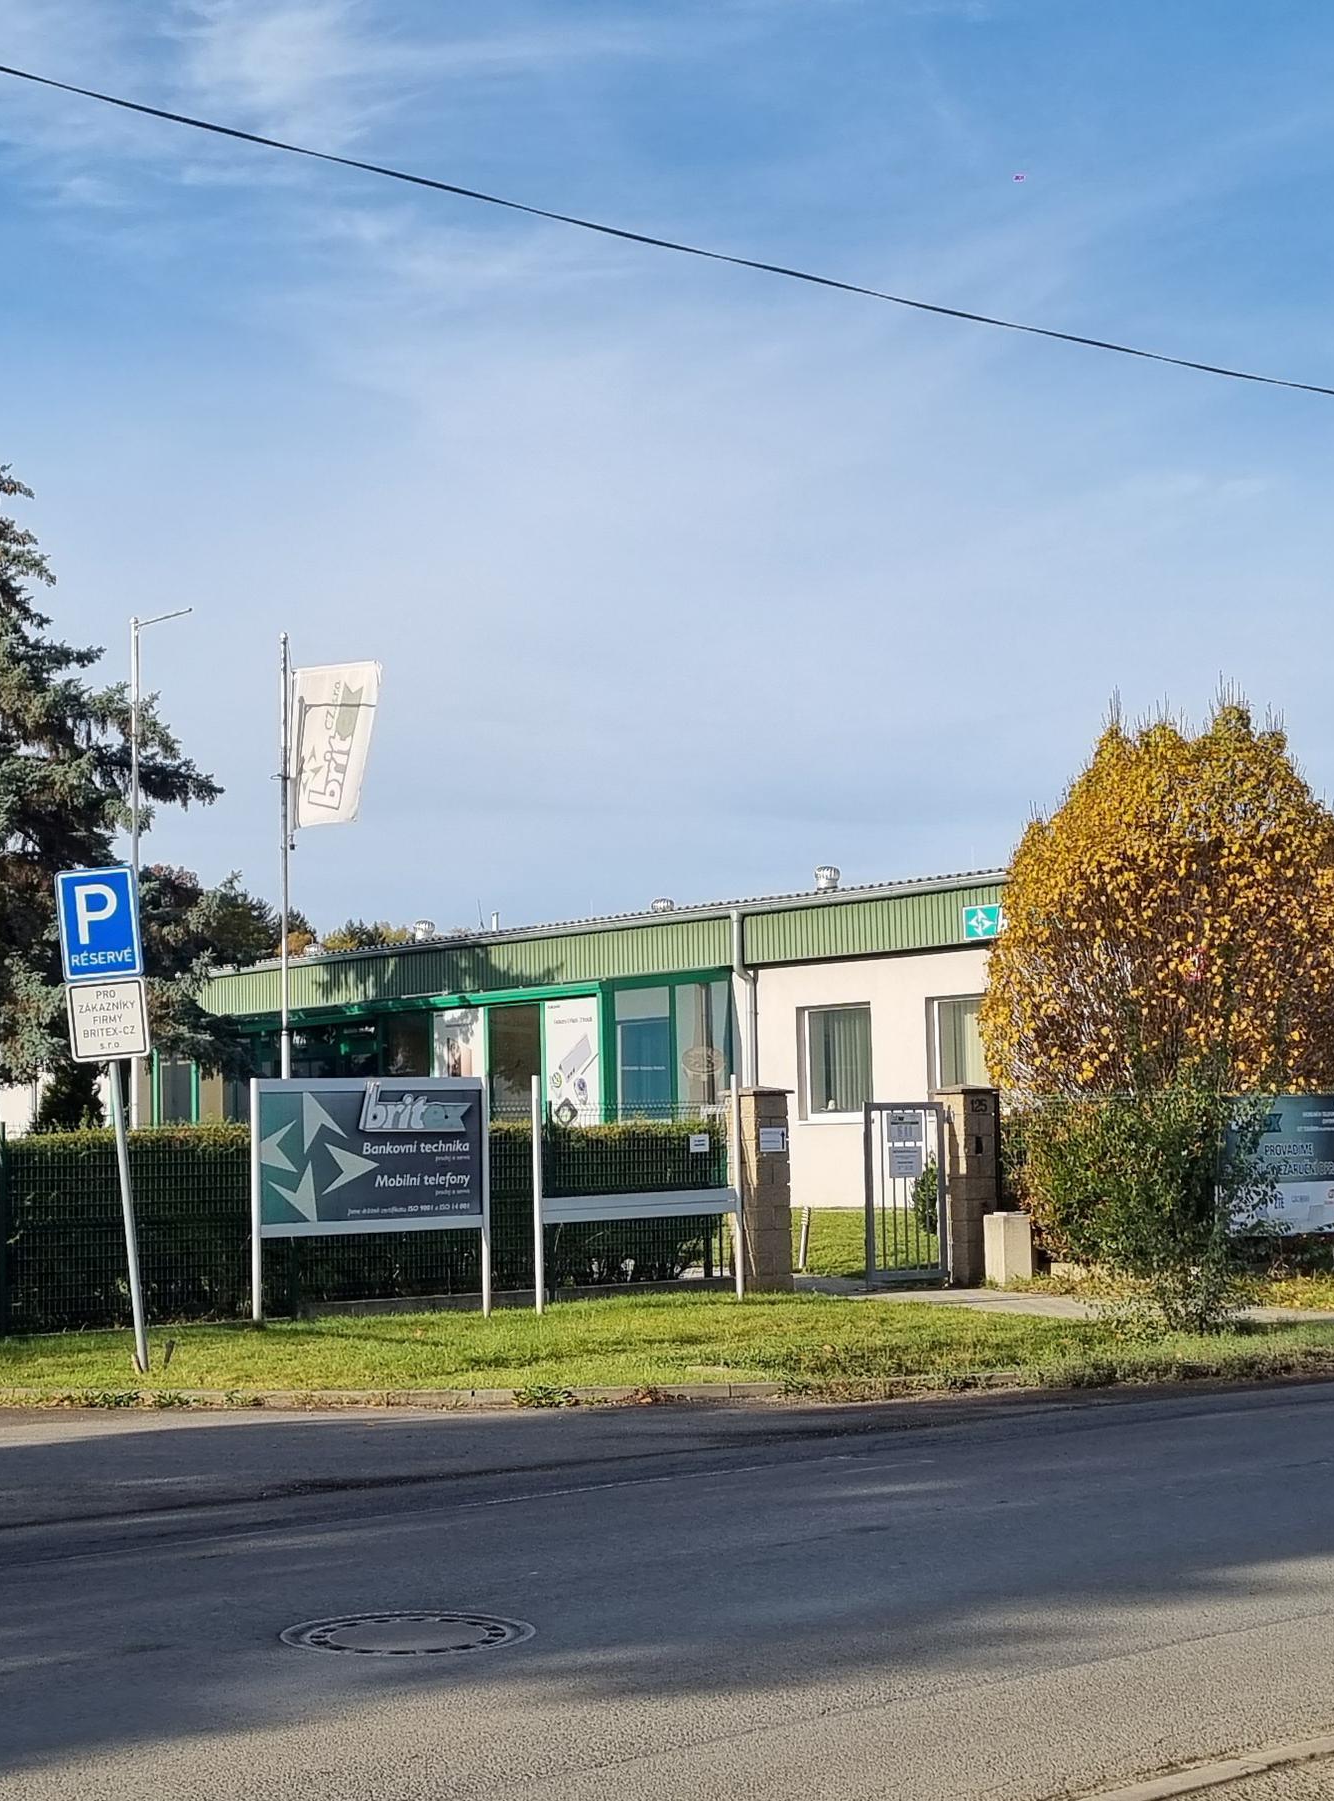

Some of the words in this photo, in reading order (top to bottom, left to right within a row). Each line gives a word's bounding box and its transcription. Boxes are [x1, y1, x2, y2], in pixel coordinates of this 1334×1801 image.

[75, 884, 117, 945] P
[71, 946, 134, 967] RÉSERVÉ
[95, 989, 116, 1000] PRO
[78, 1000, 135, 1014] ZÁKAZNÍKY
[92, 1013, 123, 1025] FIRMY
[83, 1025, 136, 1038] BRITEX-CZ
[99, 1041, 123, 1050] s.r.o.
[360, 1081, 472, 1132] britex
[971, 1098, 988, 1113] 125
[362, 1141, 417, 1155] Bankovní
[420, 1140, 470, 1153] technika
[374, 1173, 421, 1188] Mobilní
[423, 1172, 471, 1188] telefony
[439, 1203, 450, 1211] ISO
